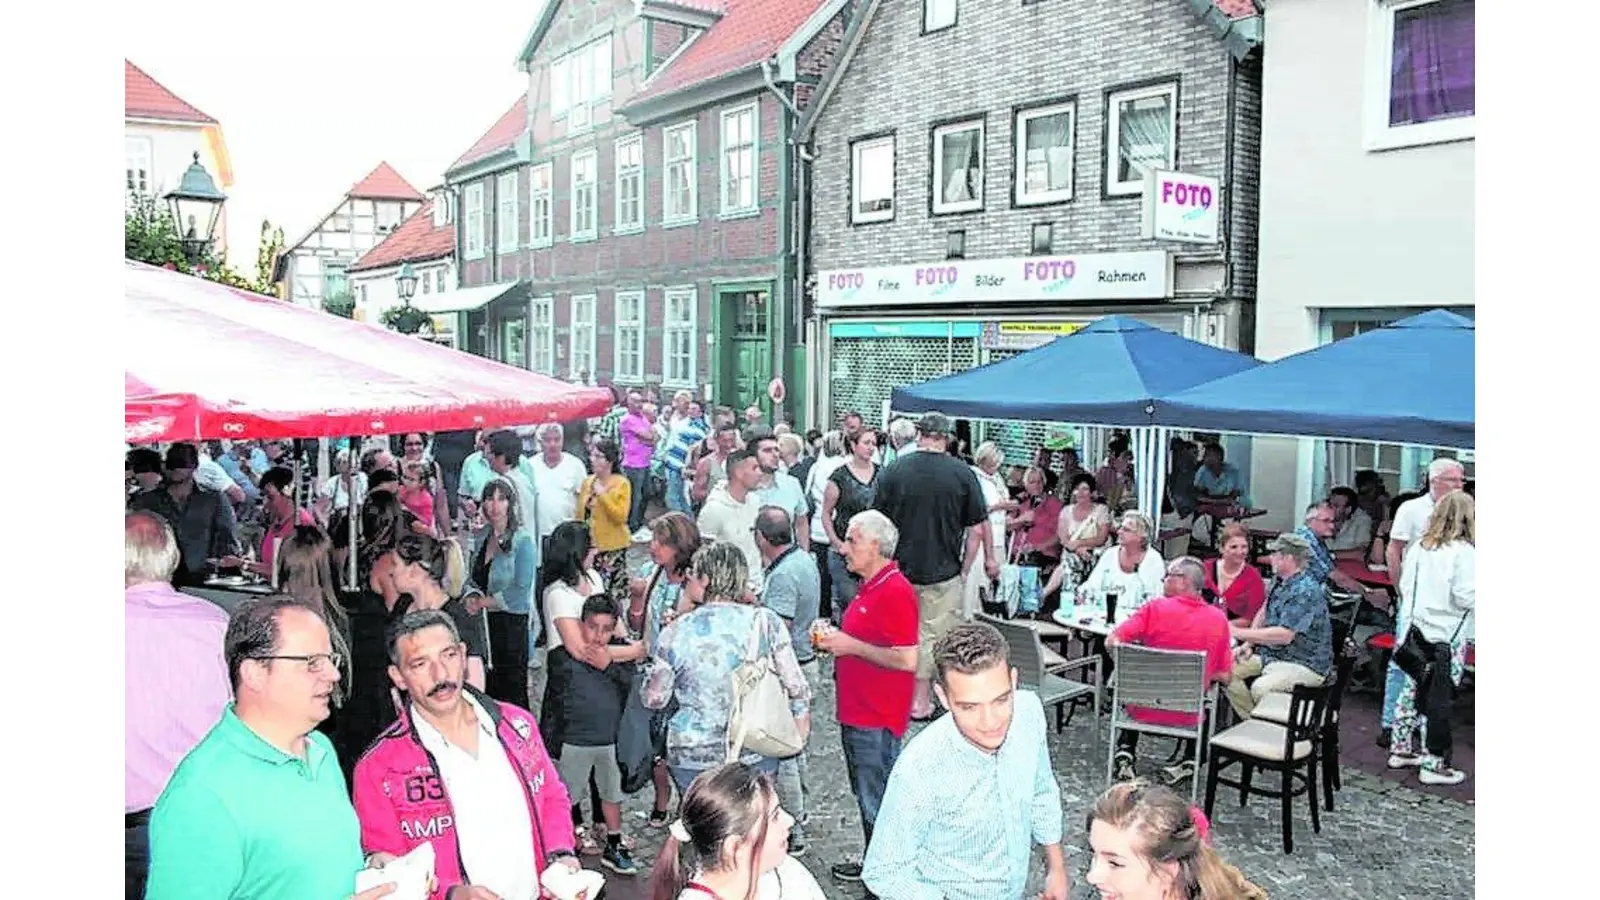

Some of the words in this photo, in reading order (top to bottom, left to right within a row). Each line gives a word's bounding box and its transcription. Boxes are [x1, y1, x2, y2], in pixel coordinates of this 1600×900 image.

[1162, 181, 1212, 210] FOTO
[828, 272, 864, 290] FOTO
[915, 265, 958, 286] FOTO
[1024, 260, 1076, 281] FOTO
[1097, 269, 1147, 283] Rahmen
[404, 774, 445, 803] 63
[400, 815, 453, 839] AMP
